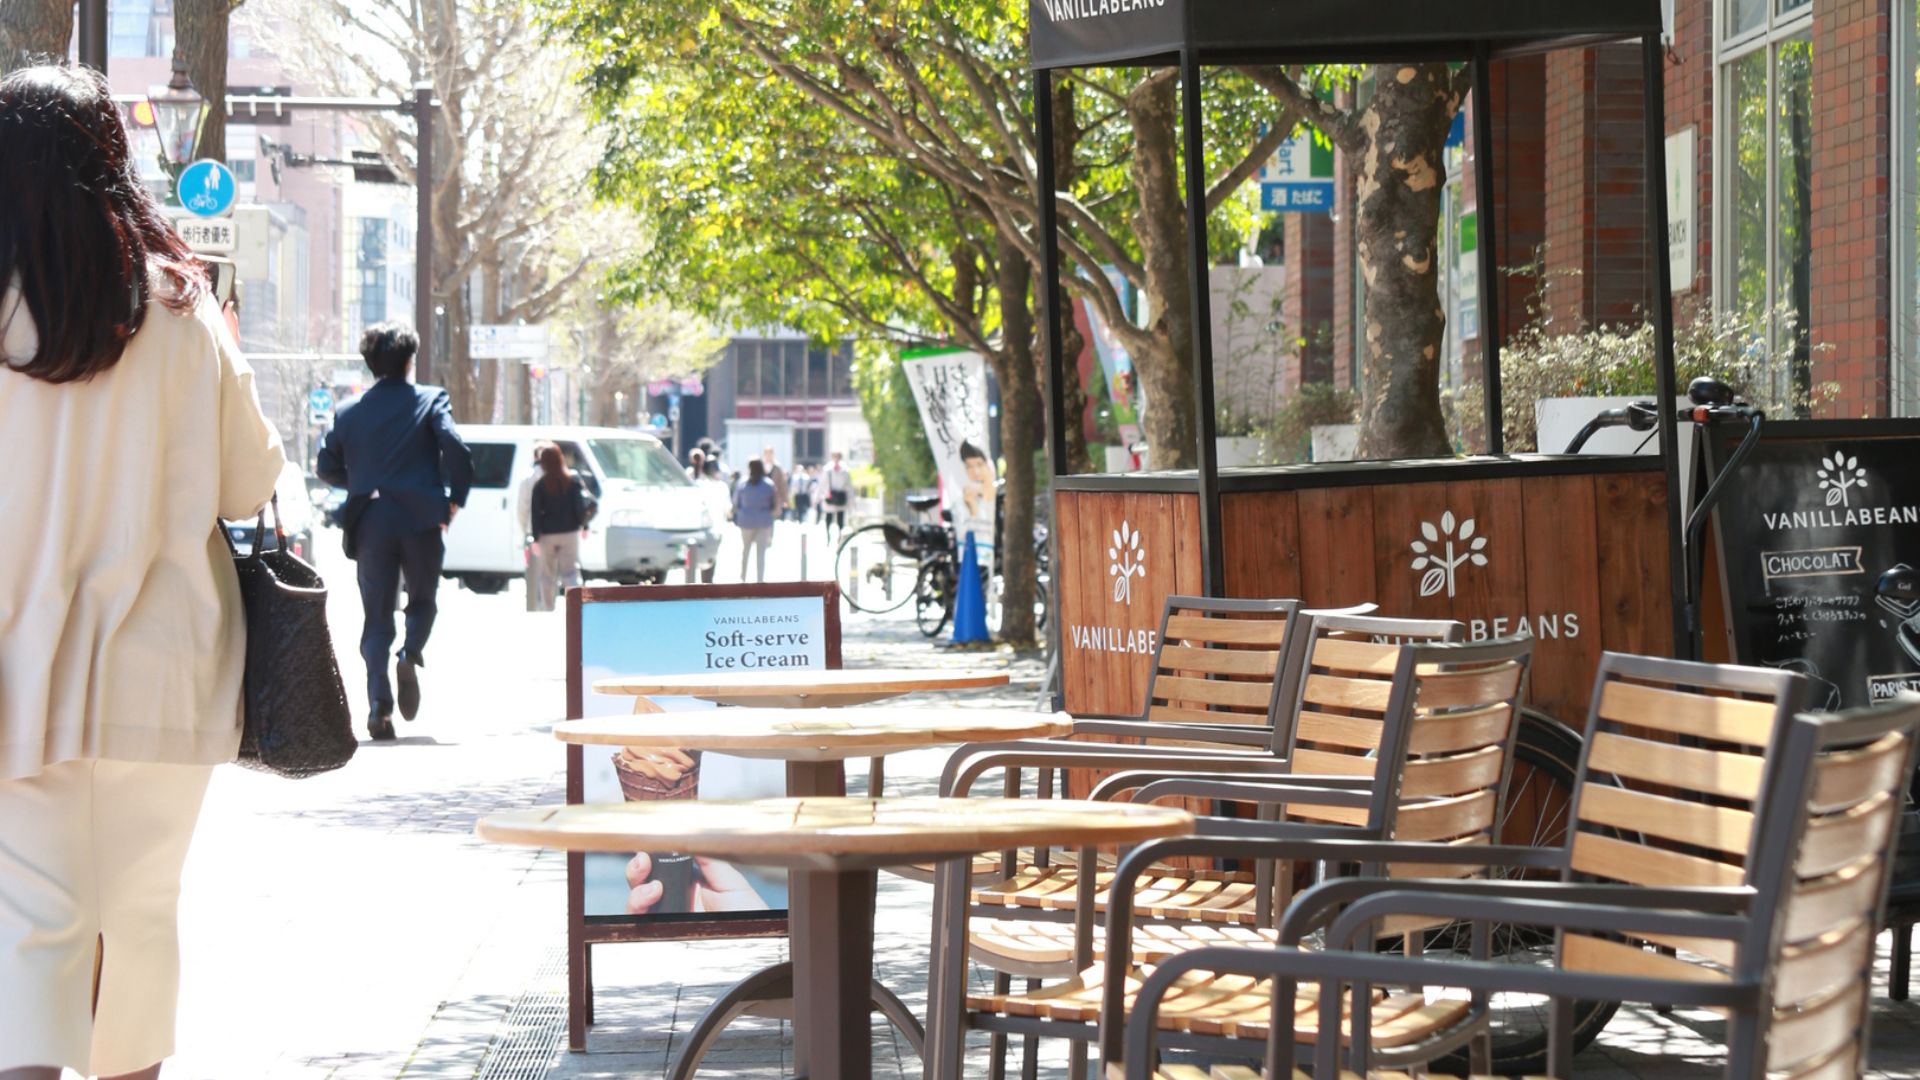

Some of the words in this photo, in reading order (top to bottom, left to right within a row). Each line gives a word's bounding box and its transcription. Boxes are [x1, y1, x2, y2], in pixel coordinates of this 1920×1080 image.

[183, 226, 231, 244] 歩行者優先
[1763, 506, 1920, 530] VANILLABEAN
[1768, 552, 1851, 574] CHOCOLAT
[713, 615, 799, 625] VANILLABEANS
[705, 630, 809, 648] Soft-serve
[1071, 625, 1157, 655] VANILLABE
[705, 652, 736, 669] Ice
[740, 651, 809, 668] Cream
[1909, 679, 1920, 693] T
